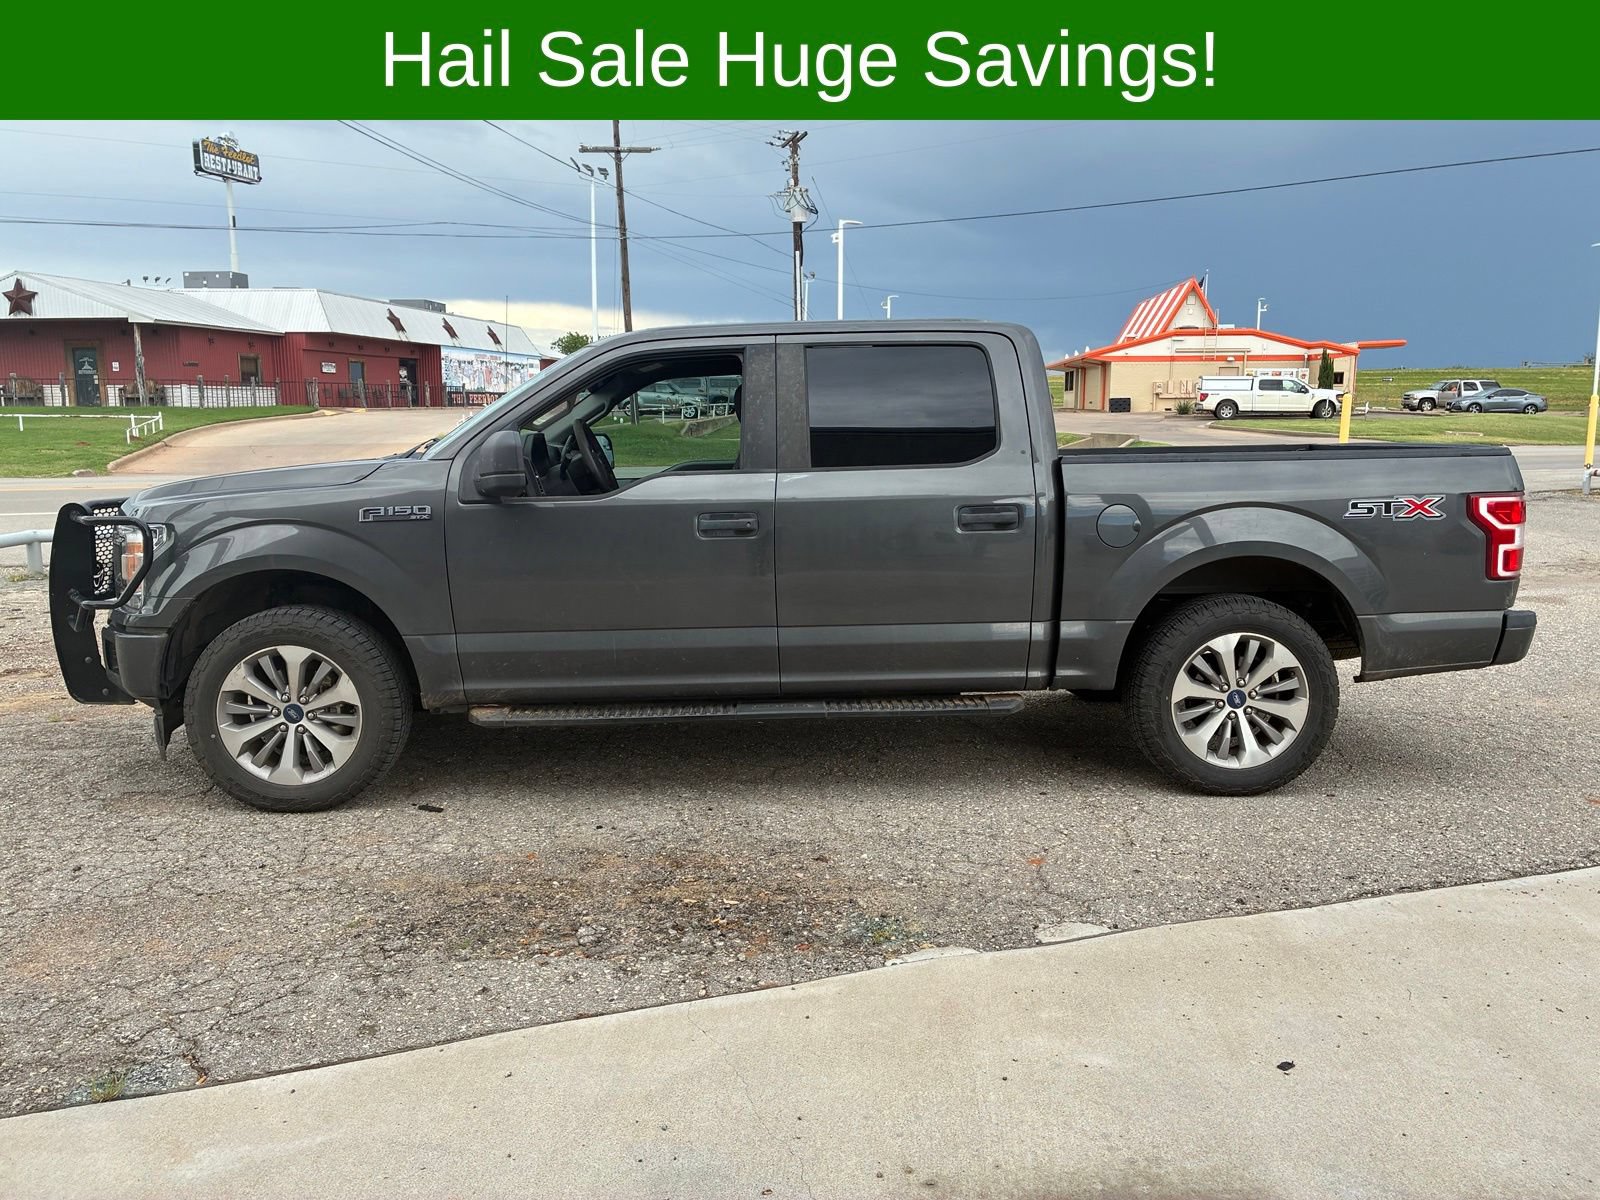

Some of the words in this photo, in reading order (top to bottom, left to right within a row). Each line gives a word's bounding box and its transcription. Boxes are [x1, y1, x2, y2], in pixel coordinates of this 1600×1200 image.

[203, 140, 219, 154] The
[203, 152, 258, 180] RESTAURANT
[1343, 495, 1446, 521] STX
